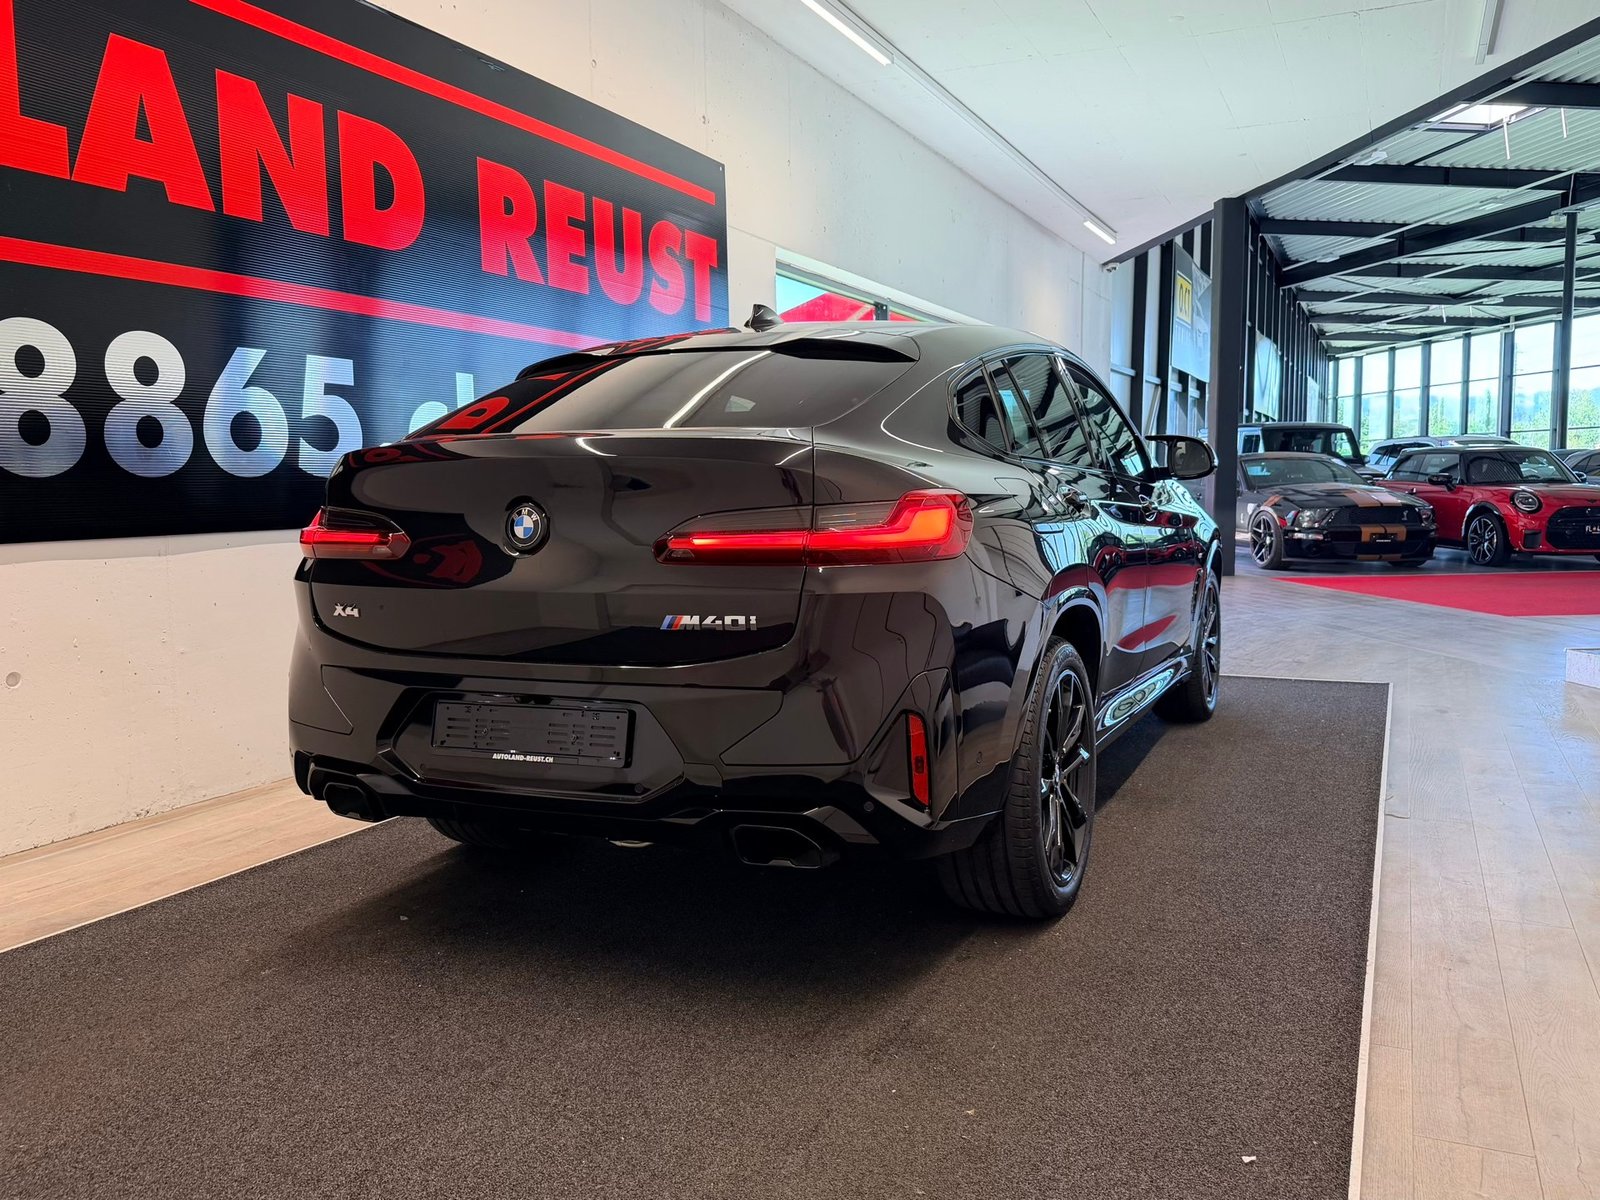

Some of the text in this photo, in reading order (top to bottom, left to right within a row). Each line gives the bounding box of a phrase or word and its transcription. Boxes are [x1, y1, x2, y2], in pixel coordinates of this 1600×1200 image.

[477, 157, 717, 322] REUST
[333, 602, 360, 618] X4
[678, 615, 757, 630] M40i
[492, 753, 554, 763] AUTOLAND-REUST.CH
